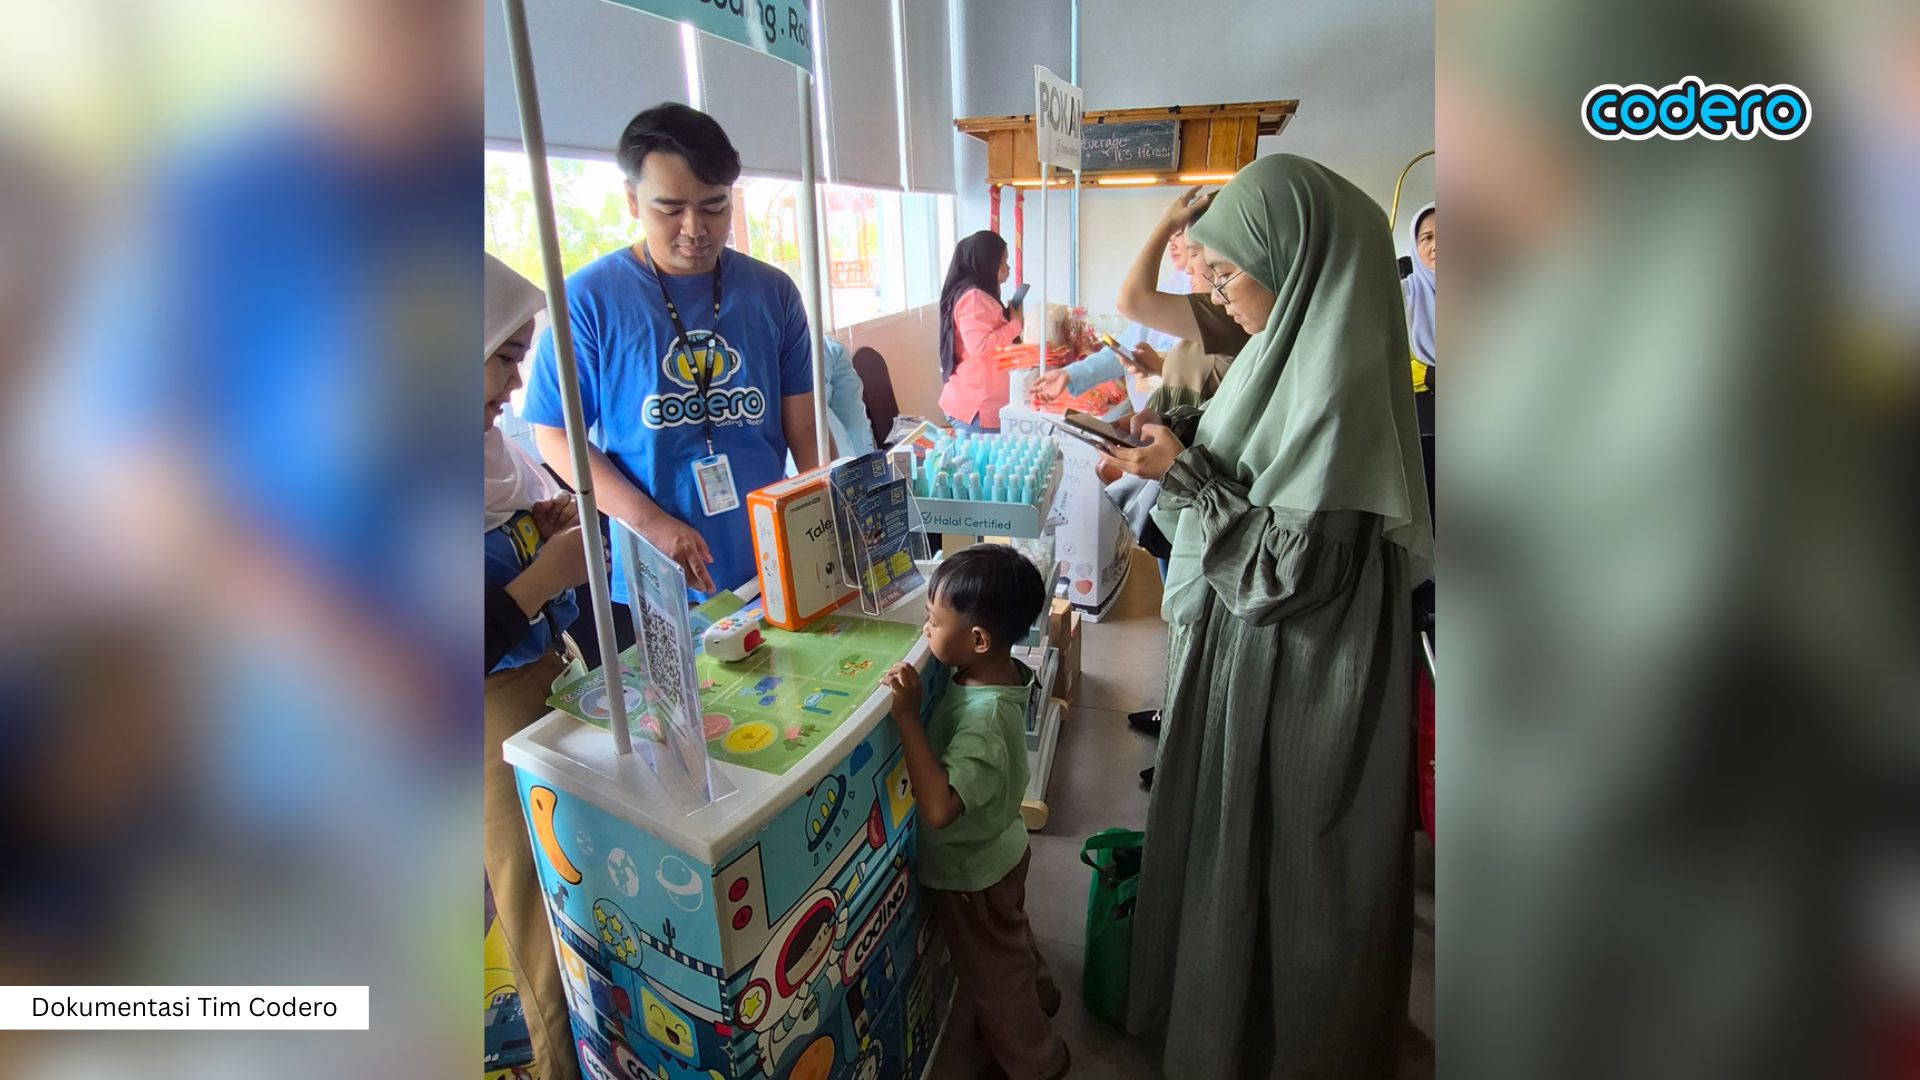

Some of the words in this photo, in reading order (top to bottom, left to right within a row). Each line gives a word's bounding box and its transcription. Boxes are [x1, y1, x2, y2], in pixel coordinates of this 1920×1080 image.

[642, 386, 766, 429] codero
[934, 515, 962, 528] Halal
[964, 517, 1012, 530] Certified
